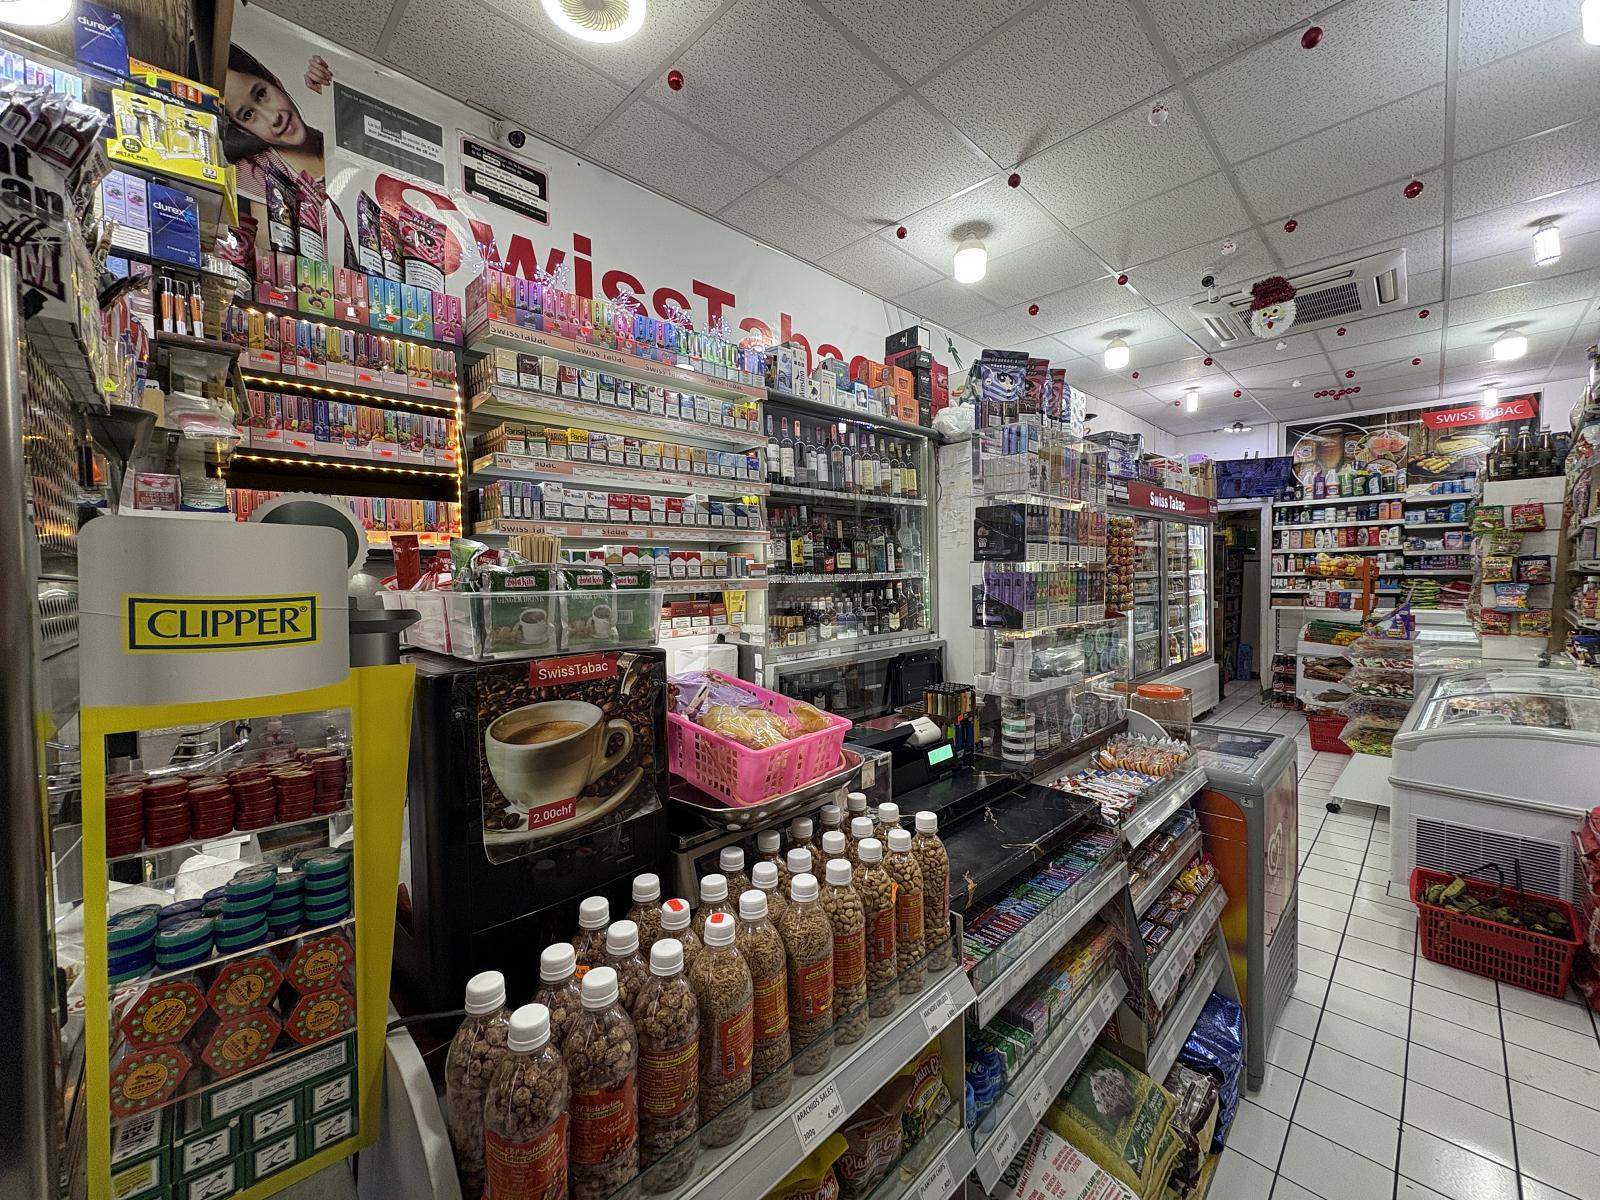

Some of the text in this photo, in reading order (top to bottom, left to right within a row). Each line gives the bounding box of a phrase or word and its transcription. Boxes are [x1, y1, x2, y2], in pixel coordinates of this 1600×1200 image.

[77, 15, 113, 31] durex
[153, 200, 188, 216] durex
[1436, 404, 1524, 425] SWISS TABAC
[1149, 491, 1186, 512] Swiss Tabac
[147, 608, 301, 639] CLIPPER
[538, 662, 609, 681] SwissTabac
[533, 804, 573, 824] 2.00chf
[820, 1086, 834, 1103] SALES
[803, 1128, 816, 1141] 300g
